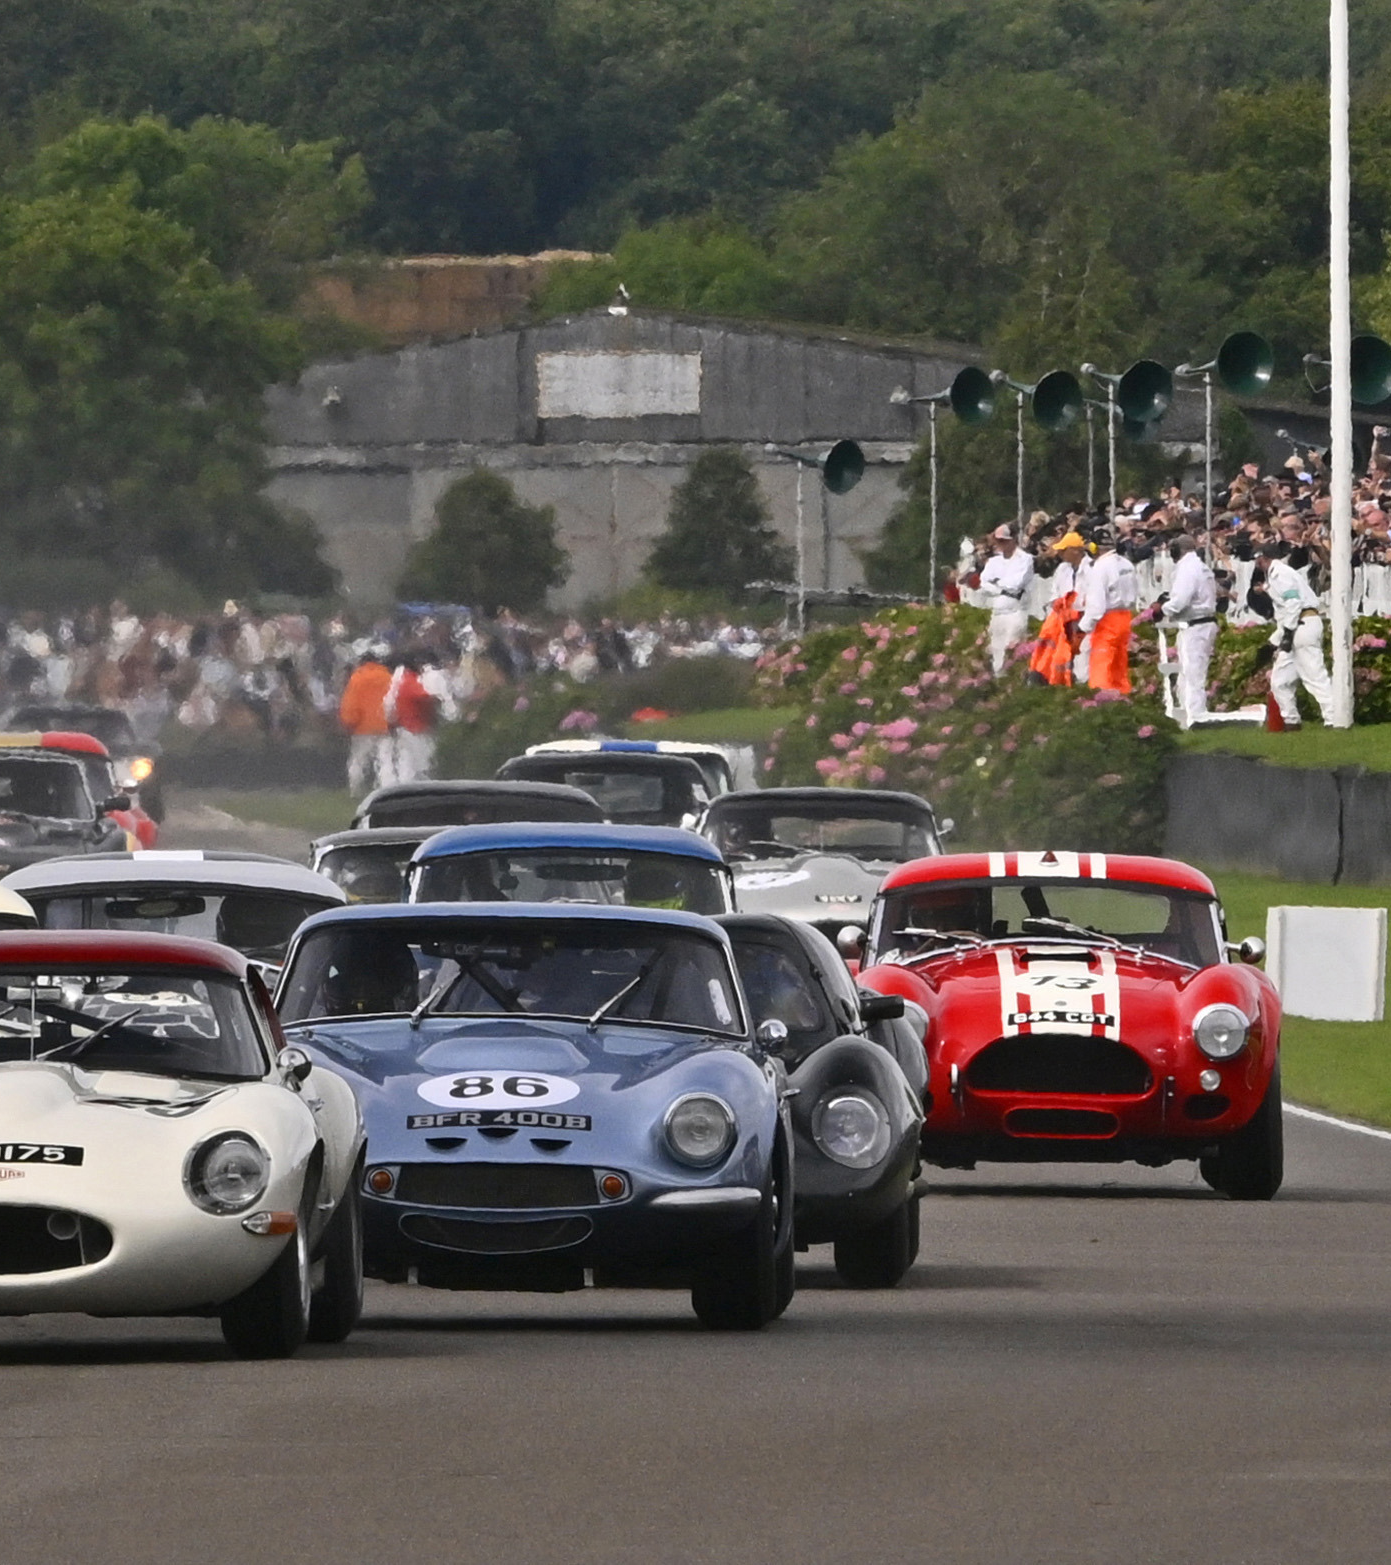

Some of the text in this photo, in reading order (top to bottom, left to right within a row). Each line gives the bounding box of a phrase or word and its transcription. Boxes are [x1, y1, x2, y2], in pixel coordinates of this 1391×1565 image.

[449, 1076, 550, 1099] 86
[412, 1111, 587, 1129] BFR 400B
